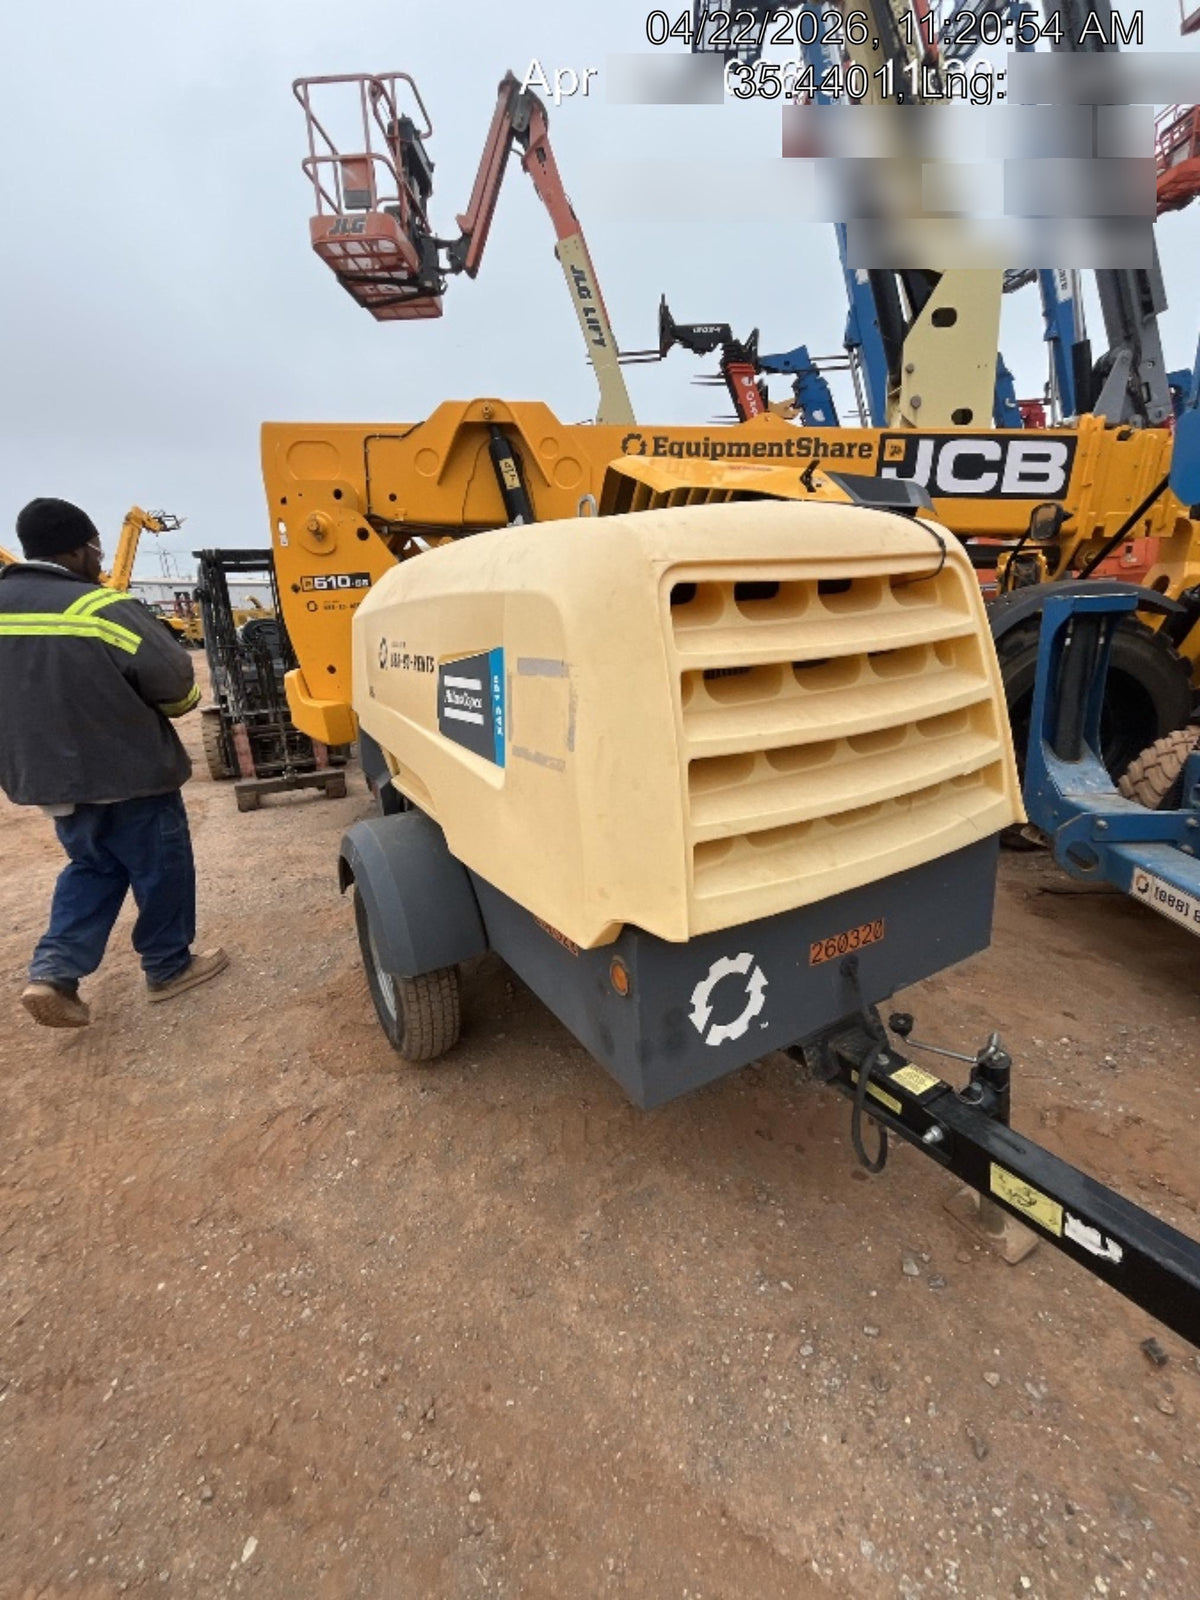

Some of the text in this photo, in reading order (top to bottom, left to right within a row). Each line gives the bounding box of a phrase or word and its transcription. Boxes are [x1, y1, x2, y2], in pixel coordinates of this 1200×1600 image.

[570, 264, 607, 347] JLG LIFT
[652, 436, 874, 460] EquipmentShare
[881, 438, 1068, 494] JCB
[811, 919, 883, 964] 260320
